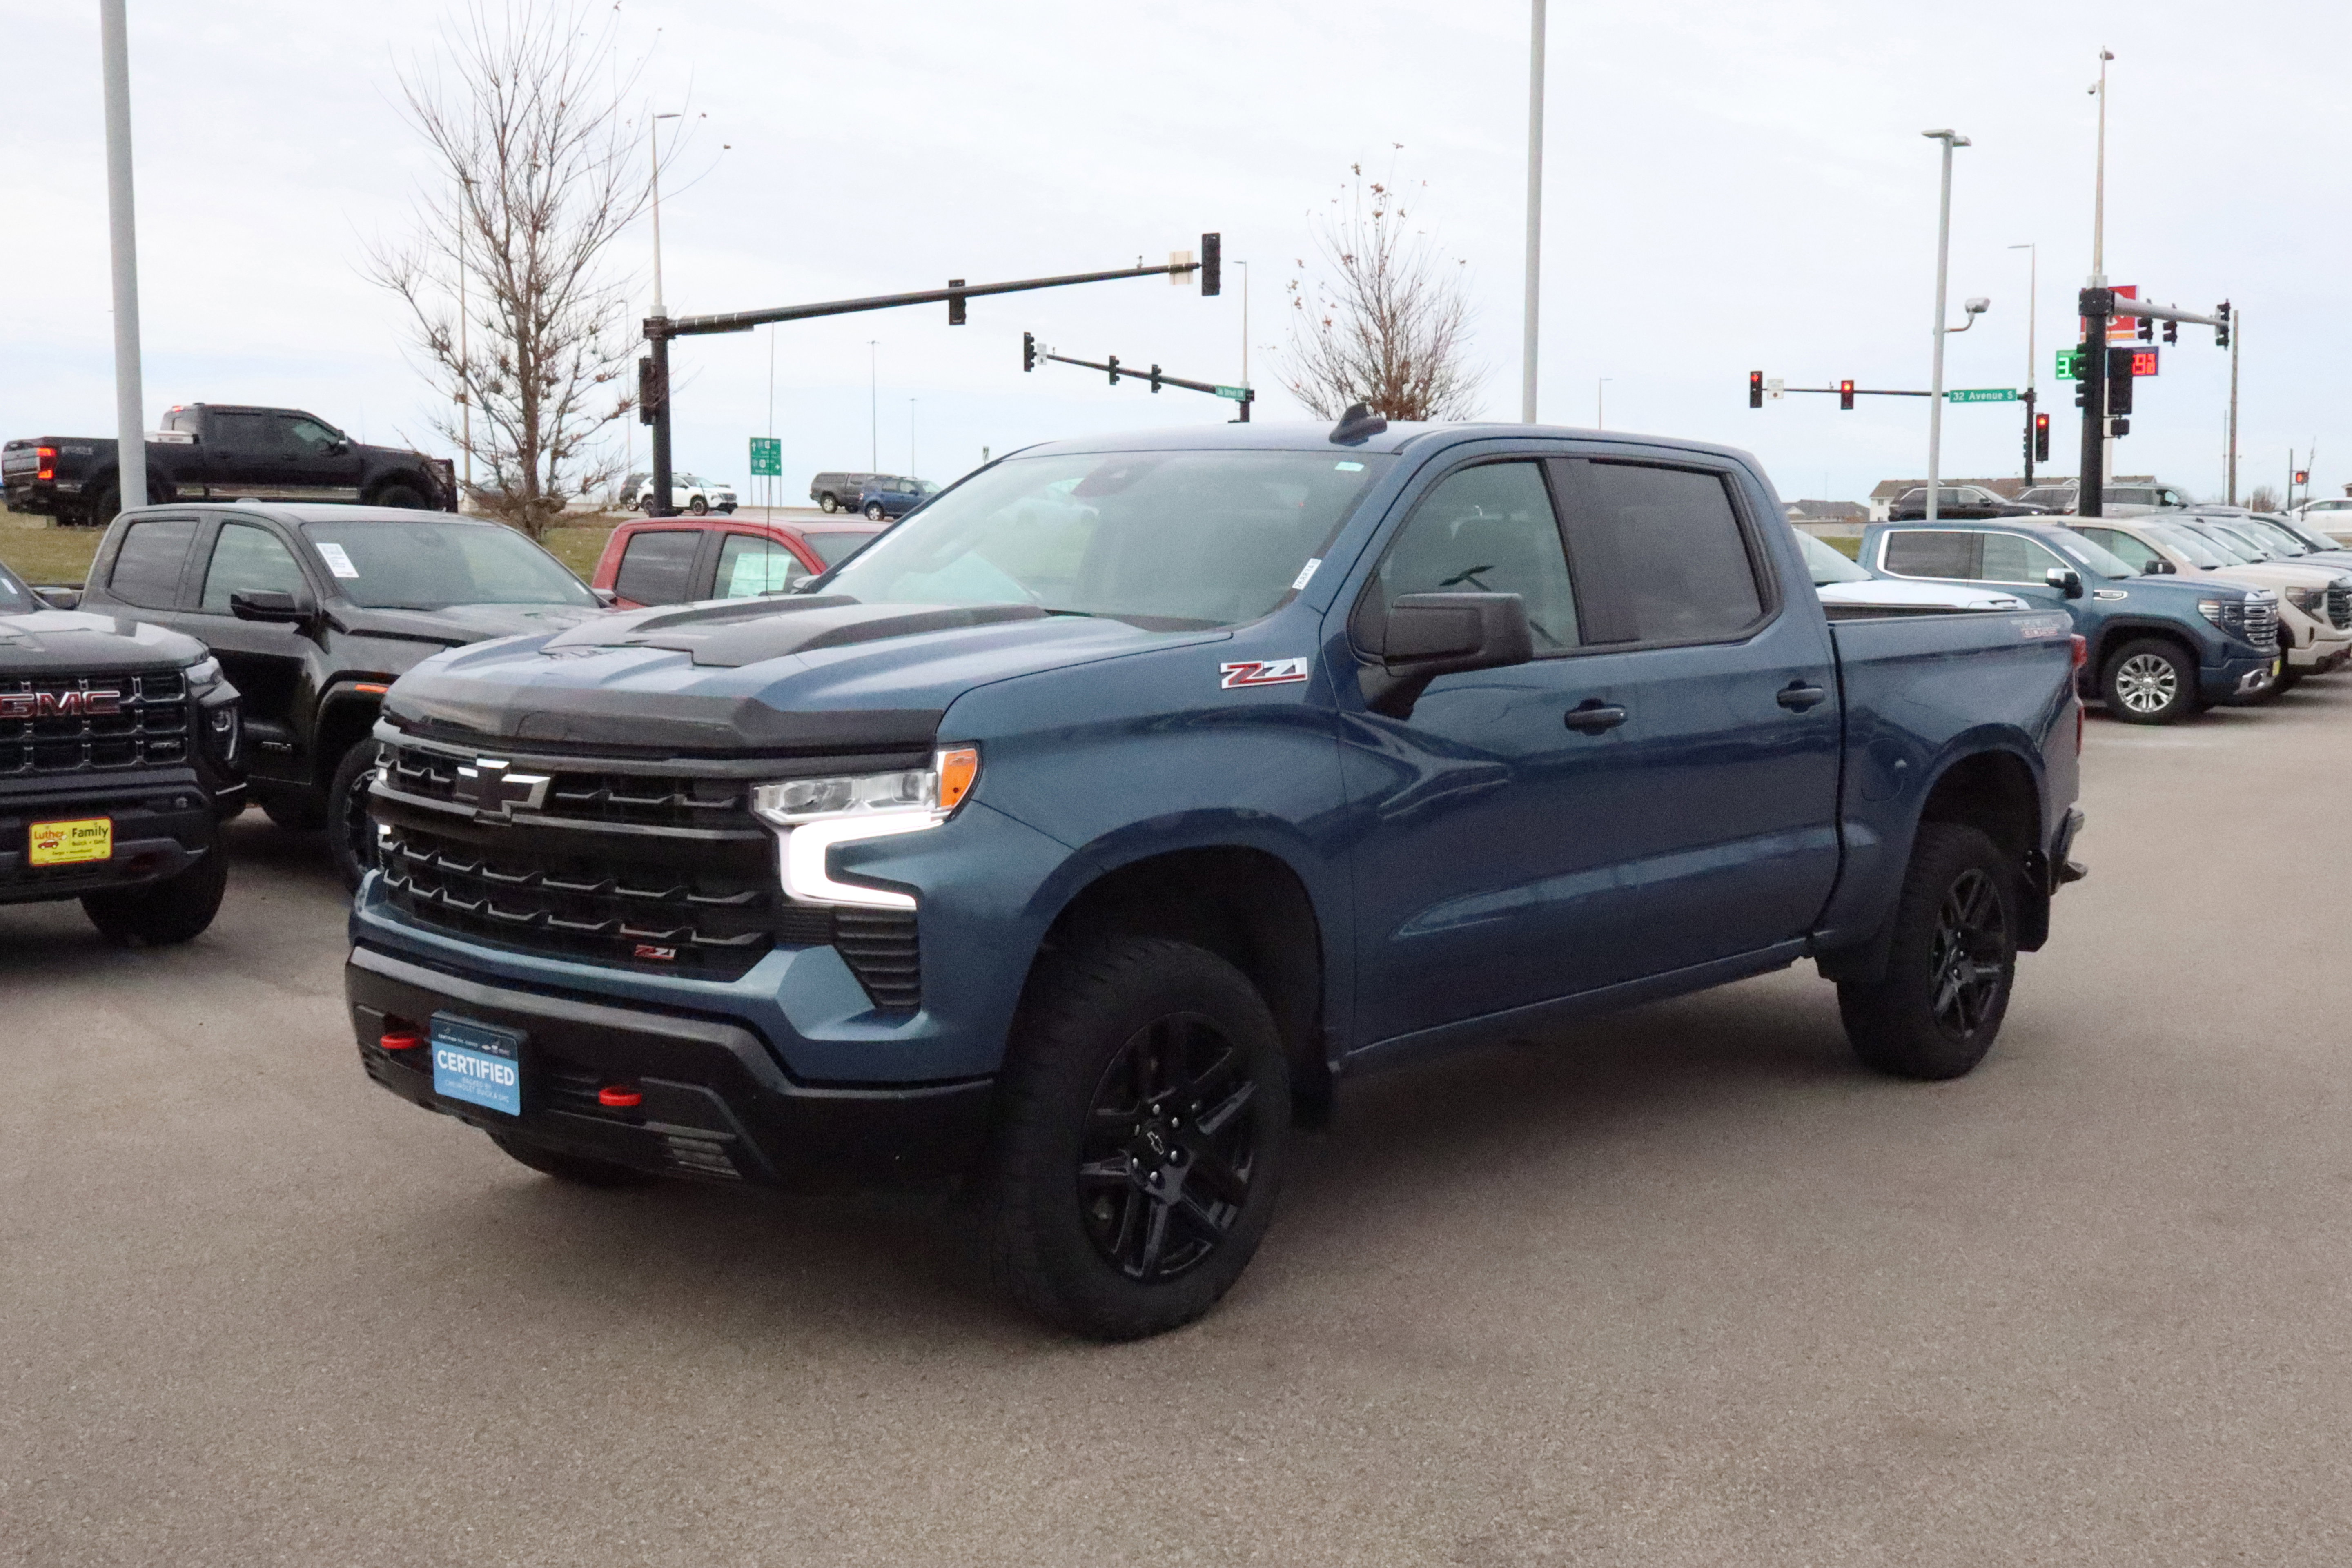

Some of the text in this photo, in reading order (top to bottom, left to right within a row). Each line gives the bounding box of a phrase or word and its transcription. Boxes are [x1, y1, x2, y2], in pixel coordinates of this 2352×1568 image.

[1953, 391, 2013, 401] 32 Avenue S
[2021, 628, 2058, 638] BOSS
[0, 690, 120, 718] GMC
[34, 826, 108, 840] Luther Family
[437, 1050, 514, 1086] CERTIFIED
